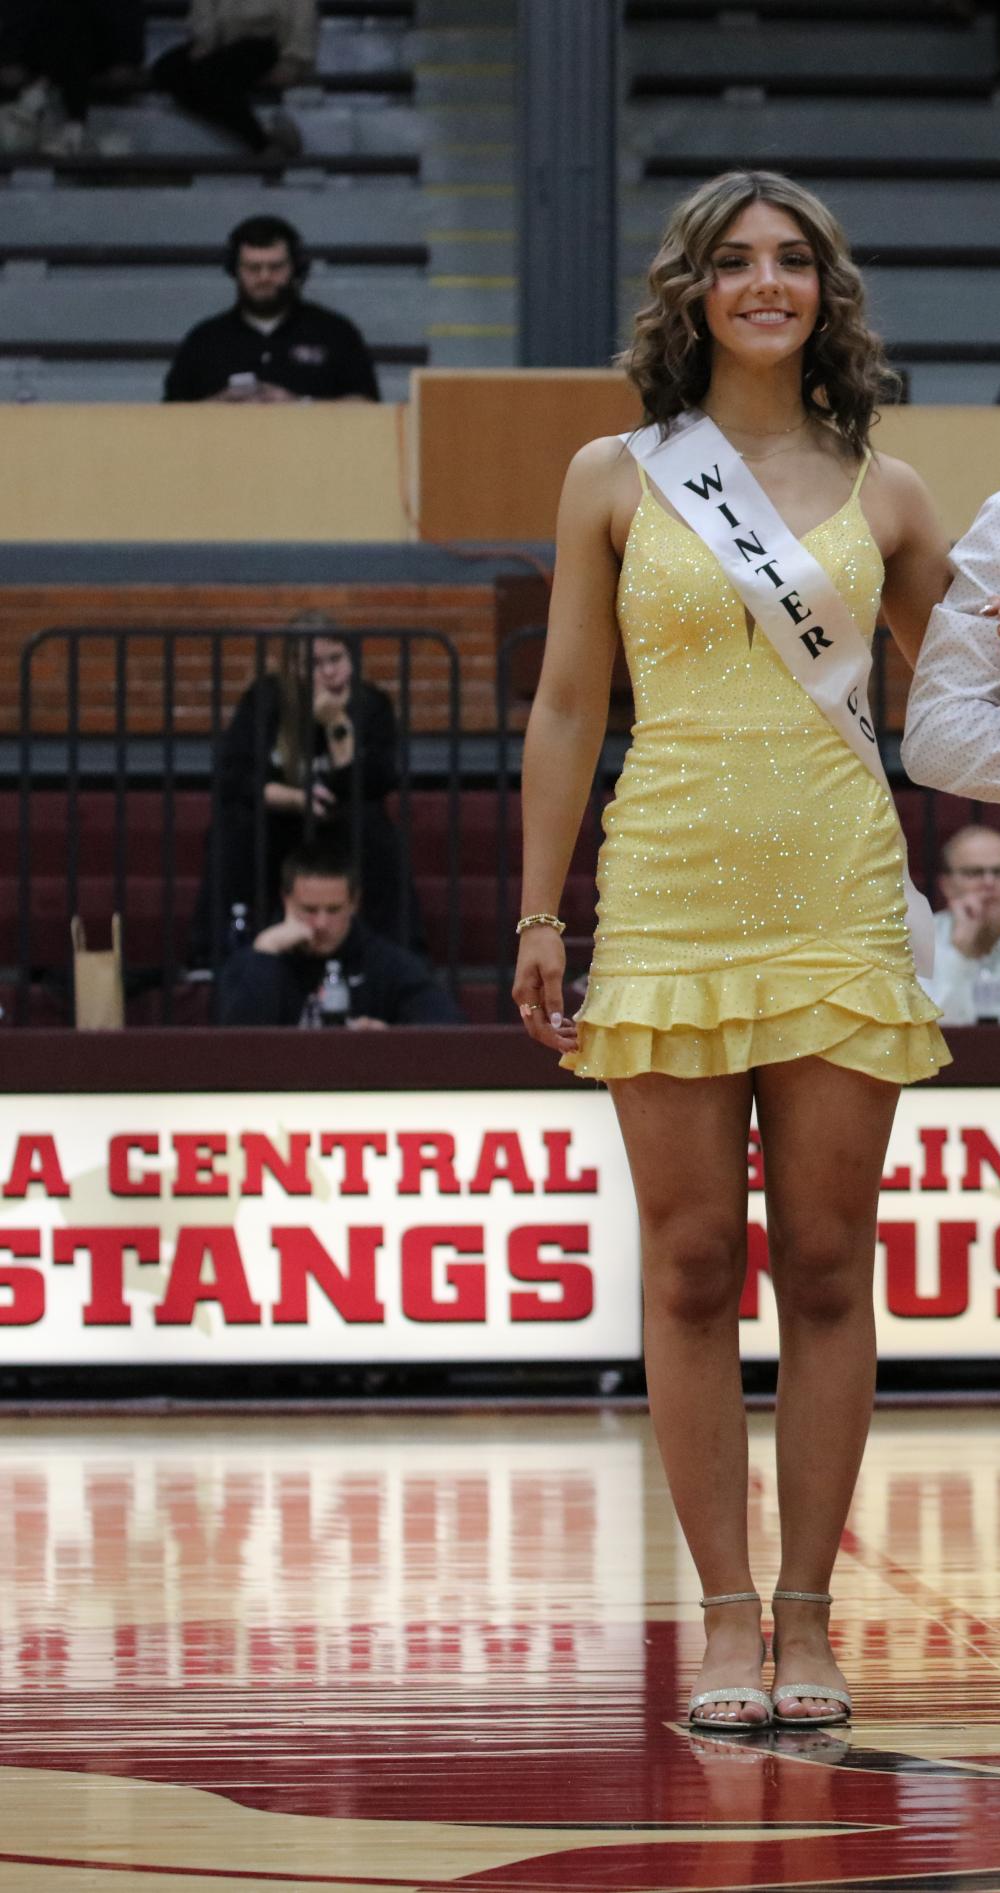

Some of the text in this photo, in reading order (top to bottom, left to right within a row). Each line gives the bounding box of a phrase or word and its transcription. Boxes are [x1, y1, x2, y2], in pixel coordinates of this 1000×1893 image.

[683, 464, 834, 659] WINTER
[1, 1130, 599, 1197] A CENTRAL
